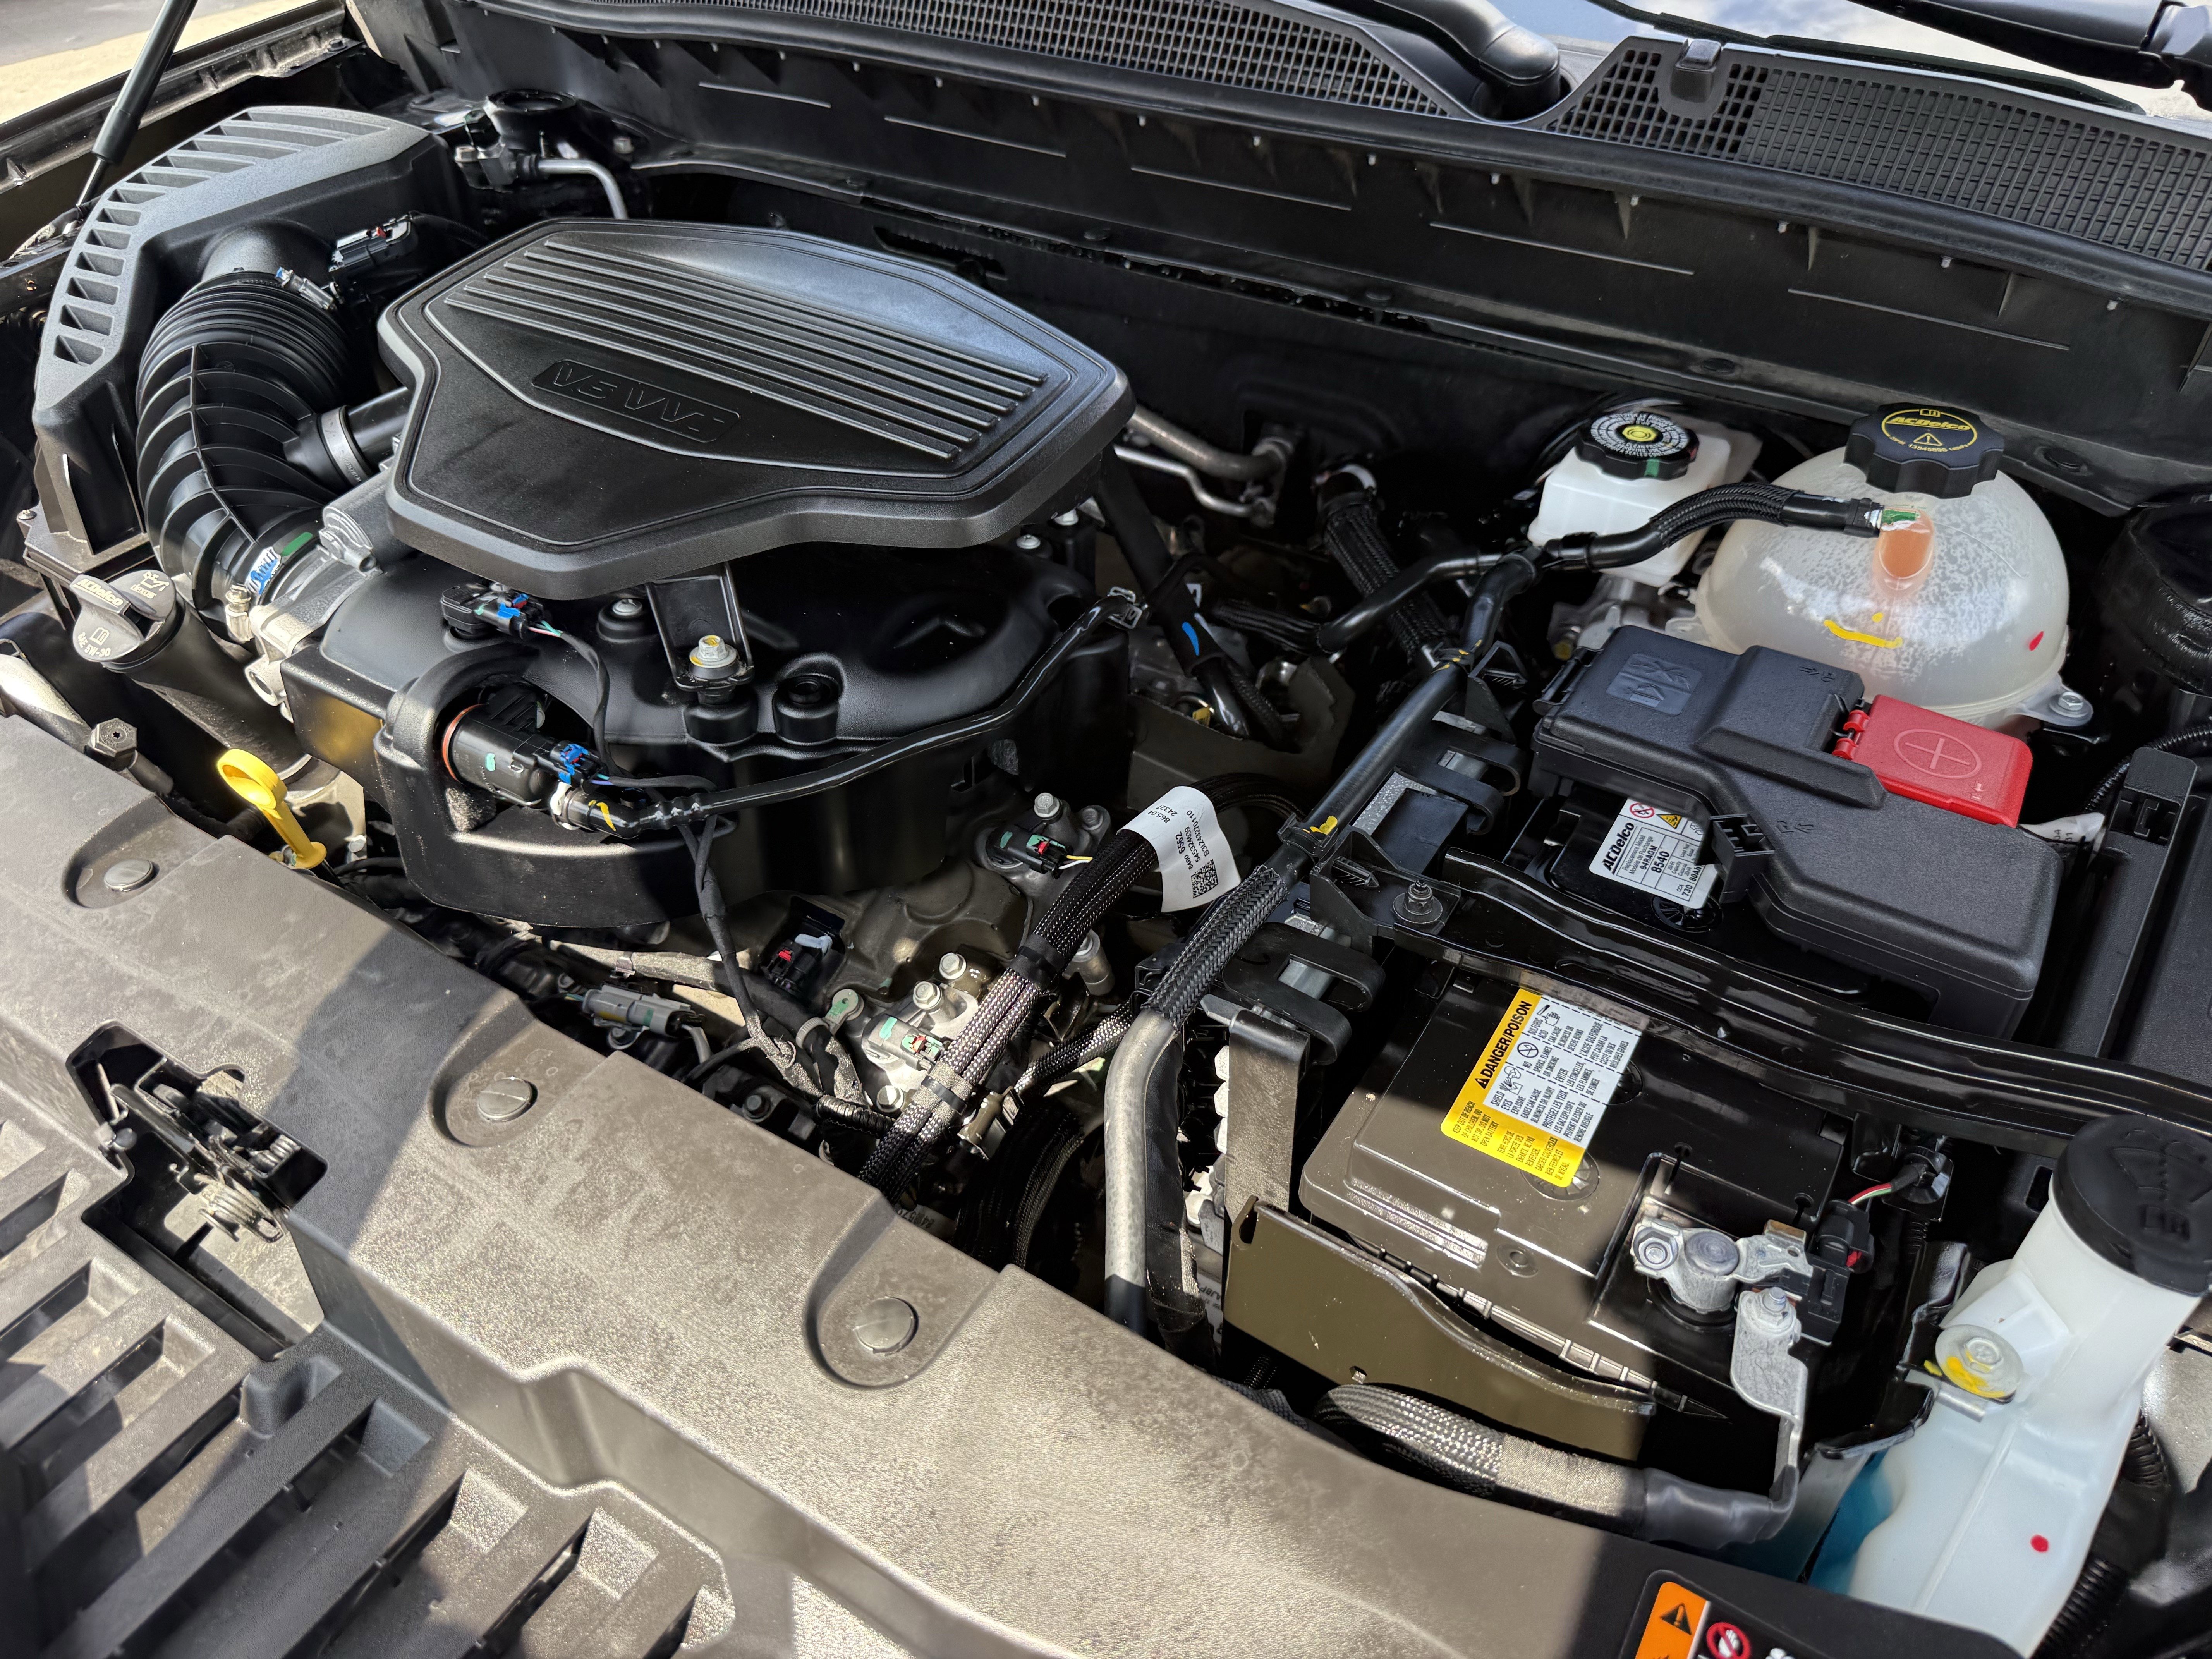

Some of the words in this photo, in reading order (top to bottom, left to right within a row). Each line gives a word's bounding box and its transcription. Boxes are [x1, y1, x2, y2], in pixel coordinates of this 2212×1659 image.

[1890, 417, 1971, 431] ACDelco
[77, 578, 124, 606] ACDelco
[130, 584, 157, 599] dexos
[78, 632, 88, 648] SAE
[84, 647, 111, 657] 5W-30
[1175, 831, 1185, 854] 6562
[1603, 823, 1634, 871] ACDelco
[1640, 844, 1657, 871] 94RAGM
[1651, 849, 1669, 874] 8540
[1689, 865, 1701, 883] 80Ah
[1681, 884, 1693, 898] 730
[1480, 1000, 1532, 1078] DANGER/POISON
[1537, 1029, 1548, 1039] ACID
[1553, 1068, 1568, 1082] ÉVITER
[1565, 1079, 1575, 1087] LES
[1575, 1083, 1585, 1091] LES
[1491, 1091, 1504, 1106] SHIELD
[1530, 1088, 1542, 1101] CAUSE
[1555, 1089, 1568, 1101] YEUX
[1501, 1099, 1513, 1111] EYES
[1510, 1095, 1526, 1114] EXPLOSIVE
[1526, 1099, 1536, 1108] CAN
[1551, 1100, 1563, 1109] LES
[1520, 1106, 1532, 1118] GASES
[1530, 1103, 1546, 1123] BLINDNESS
[1542, 1107, 1559, 1128] PROTÉGEZ
[1553, 1125, 1563, 1133] LES
